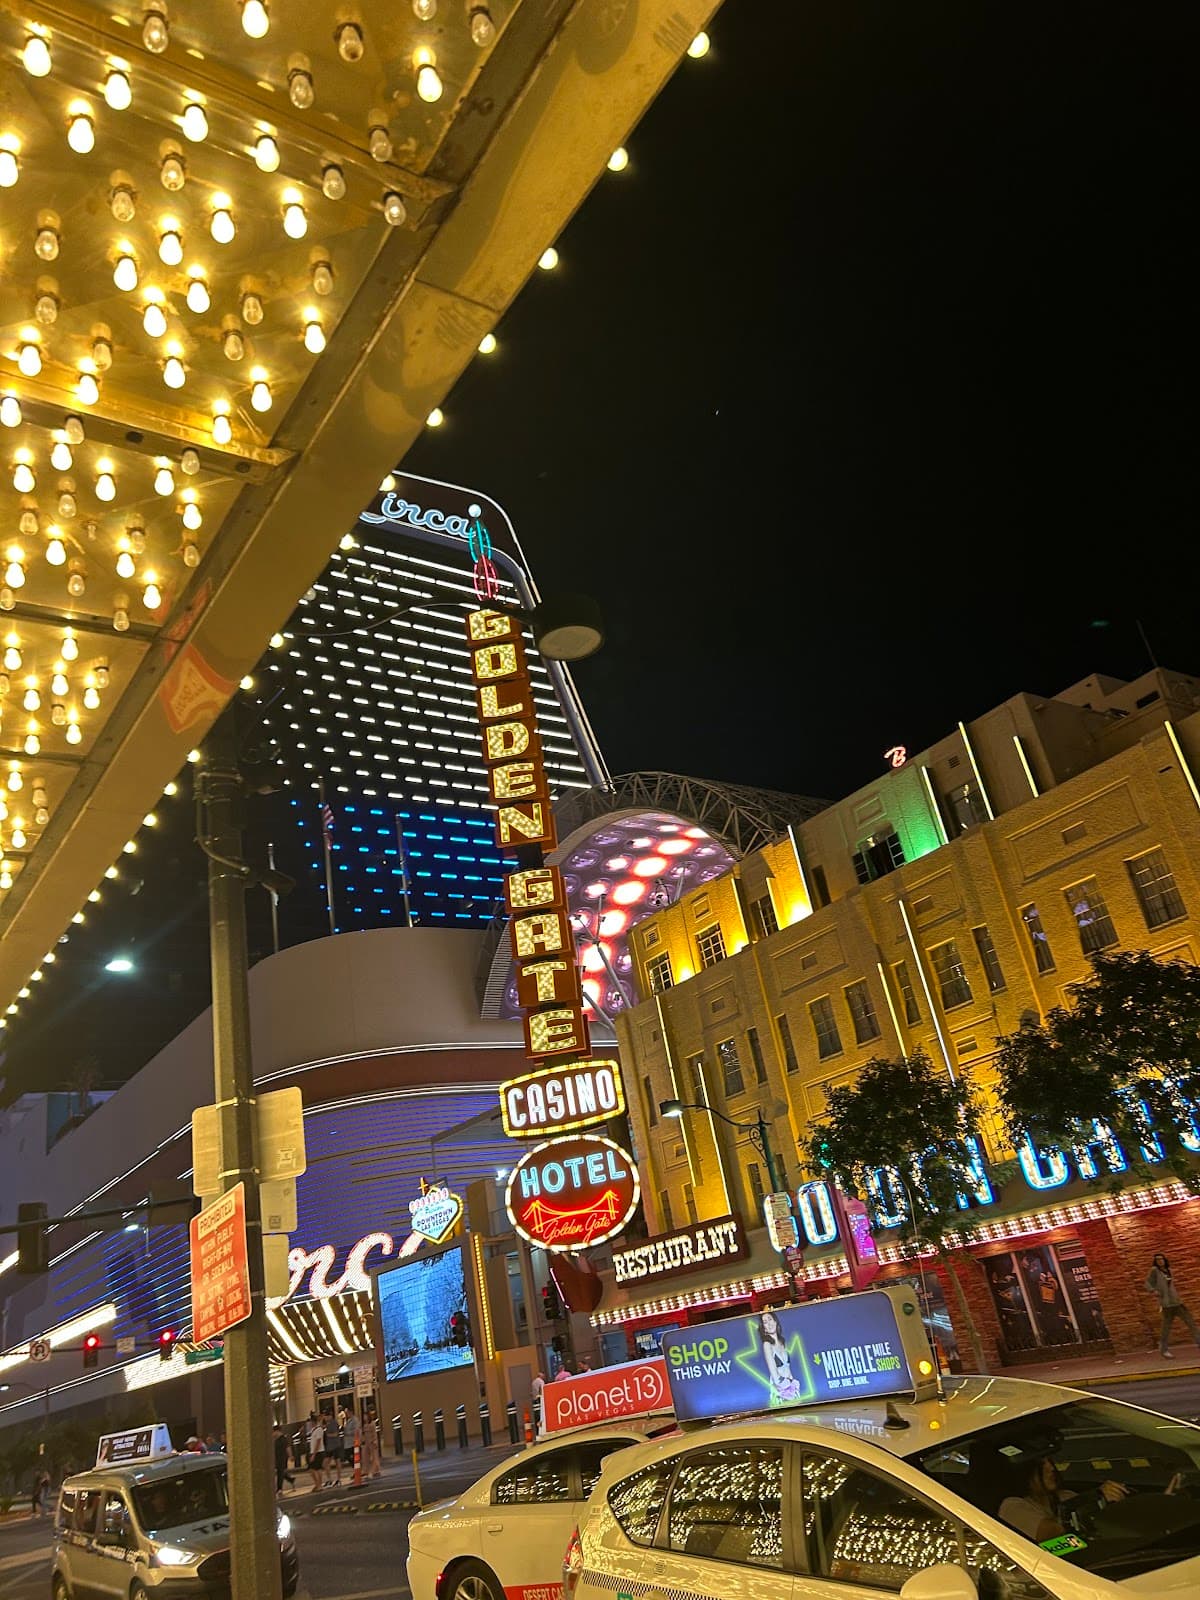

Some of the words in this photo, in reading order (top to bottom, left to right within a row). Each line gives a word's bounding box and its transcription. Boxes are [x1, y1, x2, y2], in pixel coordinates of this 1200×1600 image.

[360, 492, 476, 538] irca
[469, 609, 543, 843] GOLDEN
[508, 868, 577, 1053] GATE
[507, 1069, 616, 1128] CASINO
[520, 1150, 627, 1198] HOTEL
[199, 1198, 232, 1233] PROHIBITED
[416, 1207, 453, 1227] DOWNTOWN
[421, 1223, 431, 1232] LAS
[432, 1216, 450, 1227] VEGAS
[543, 1218, 584, 1245] Golden
[583, 1212, 611, 1244] Gate
[612, 1221, 739, 1283] RESTAURANT
[669, 1337, 729, 1366] SHOP
[821, 1345, 877, 1379] MIRACLE
[872, 1342, 892, 1357] MILE
[876, 1356, 901, 1371] SHOPS
[672, 1366, 702, 1381] THIS
[703, 1360, 732, 1376] WAY
[557, 1379, 634, 1425] planet
[633, 1374, 657, 1401] 13
[569, 1414, 590, 1424] LAS
[597, 1405, 636, 1417] VEGAS
[192, 1519, 231, 1534] TA
